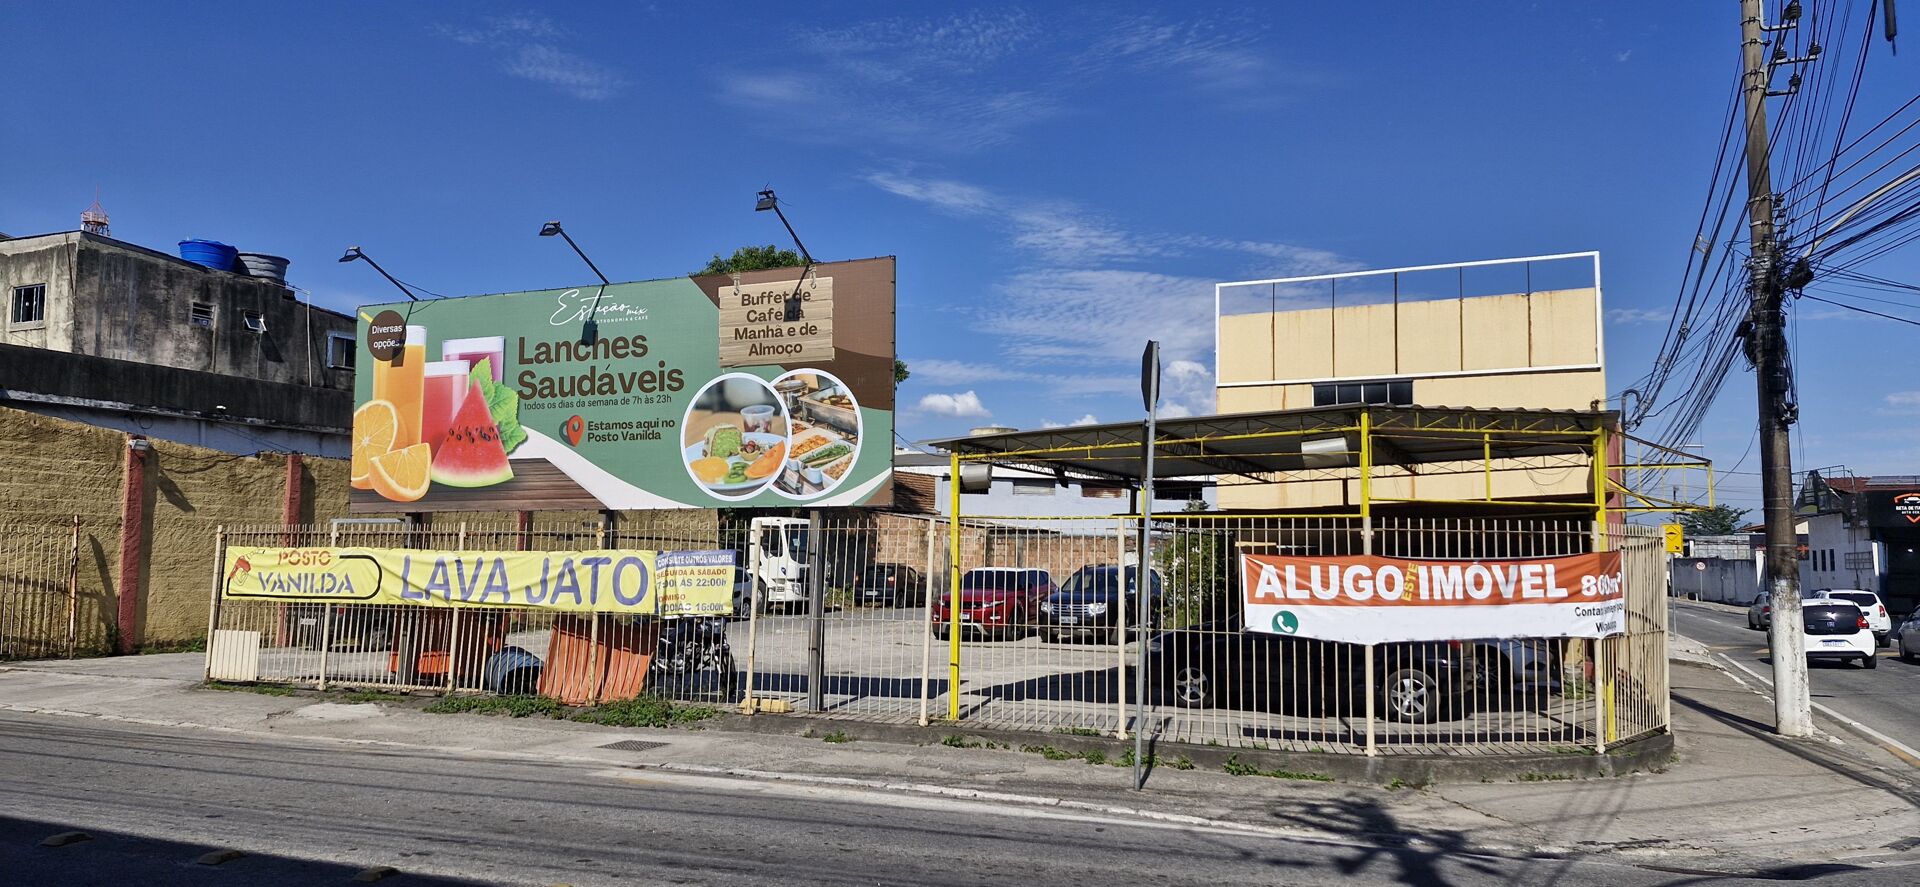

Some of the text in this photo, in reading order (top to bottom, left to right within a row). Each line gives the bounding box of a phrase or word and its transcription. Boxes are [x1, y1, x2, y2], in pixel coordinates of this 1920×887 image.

[741, 290, 790, 306] Buffet
[746, 307, 783, 322] Café
[371, 324, 402, 335] Diversas
[734, 322, 818, 340] Manhã e de
[518, 335, 649, 365] Lanches
[748, 343, 803, 357] Almoço
[517, 360, 685, 400] Saudáveis
[524, 394, 672, 411] todos os dias da semana de 7h às 23h
[587, 418, 675, 433] Estamos aqui no
[587, 430, 662, 443] Posto Vanilda
[277, 550, 332, 566] POSTO
[686, 554, 709, 565] OUTROS
[709, 553, 733, 563] VALORES
[257, 572, 355, 594] VANILDA
[400, 555, 649, 607] LAVA JATO
[696, 577, 727, 587] 22:00h
[1255, 564, 1405, 601] ALUGO
[1401, 562, 1418, 602] ESTE
[1418, 561, 1568, 600] IMÓVEL
